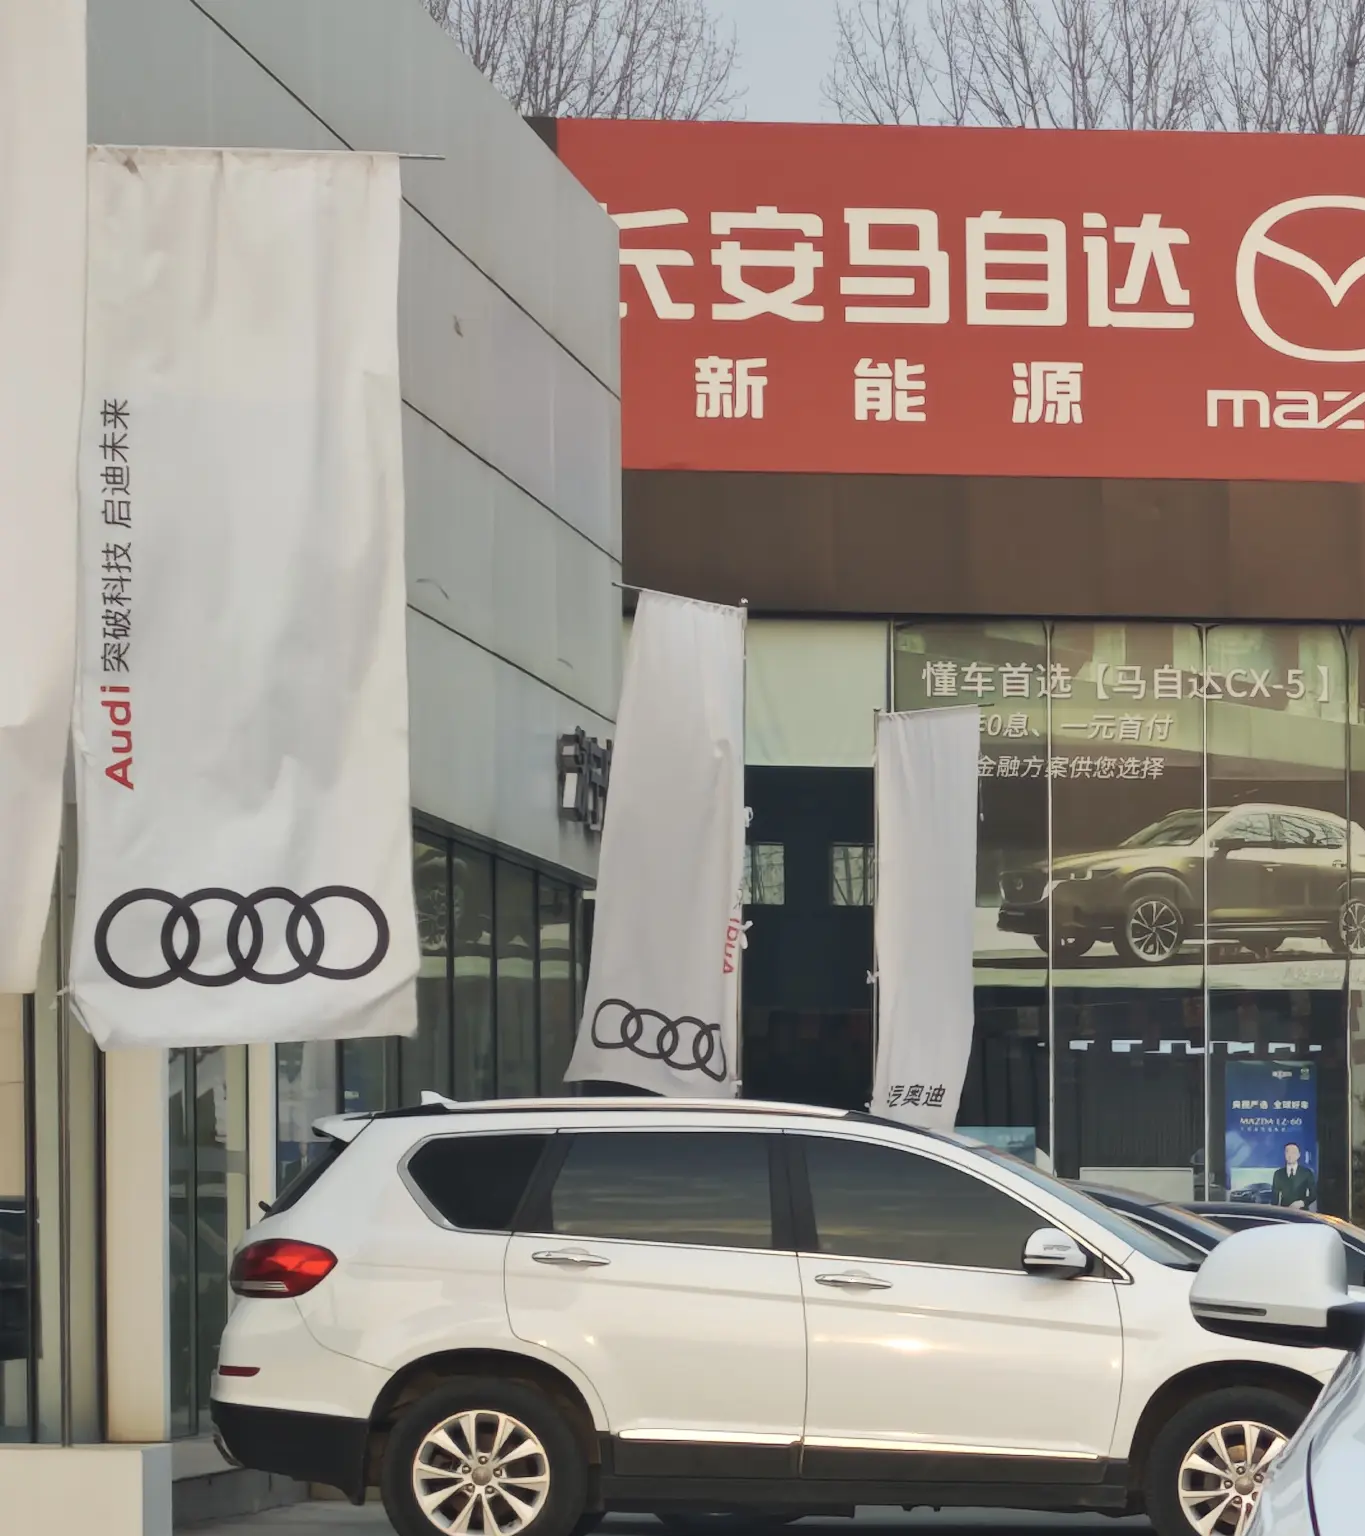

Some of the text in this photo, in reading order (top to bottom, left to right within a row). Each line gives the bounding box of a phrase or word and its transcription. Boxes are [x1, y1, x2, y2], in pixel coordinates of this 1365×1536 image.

[619, 205, 1194, 328] 长安马自达
[694, 357, 1085, 425] 新能源
[99, 399, 134, 790] Audi 突破科技 启迪未来
[978, 714, 1174, 742] 0息、一元首付
[978, 757, 1165, 780] 金融方案供您选择
